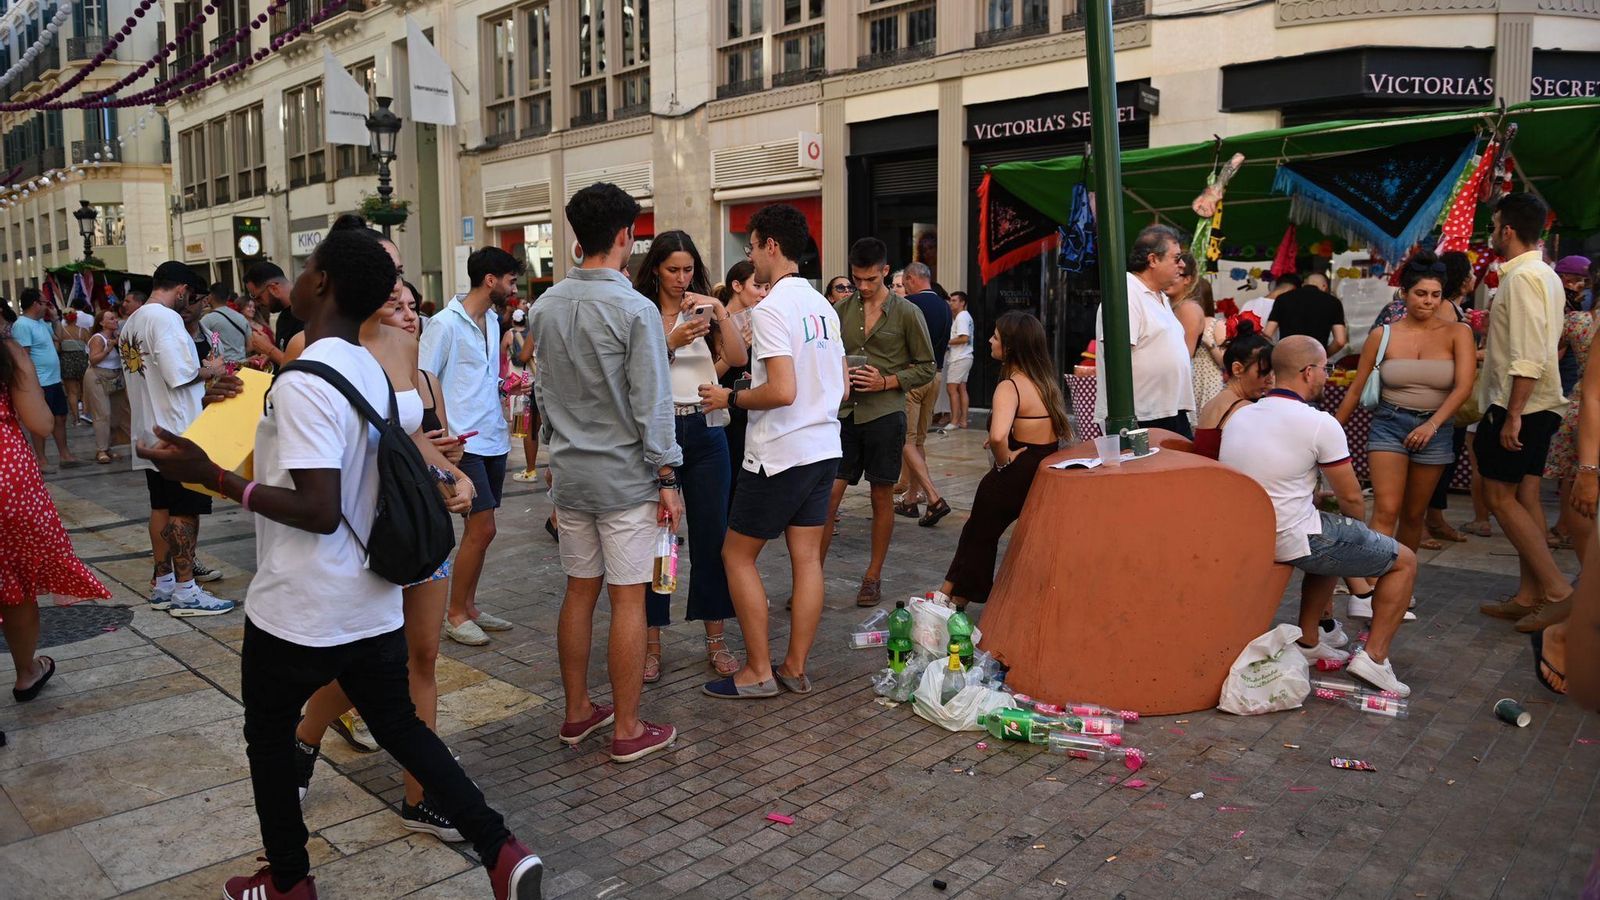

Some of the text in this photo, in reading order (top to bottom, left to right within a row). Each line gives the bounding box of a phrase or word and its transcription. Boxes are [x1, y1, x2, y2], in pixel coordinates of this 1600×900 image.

[1369, 73, 1494, 96] VICTORIA'S
[974, 106, 1136, 140] VICTORIA'S SEET
[298, 232, 321, 248] KIKO
